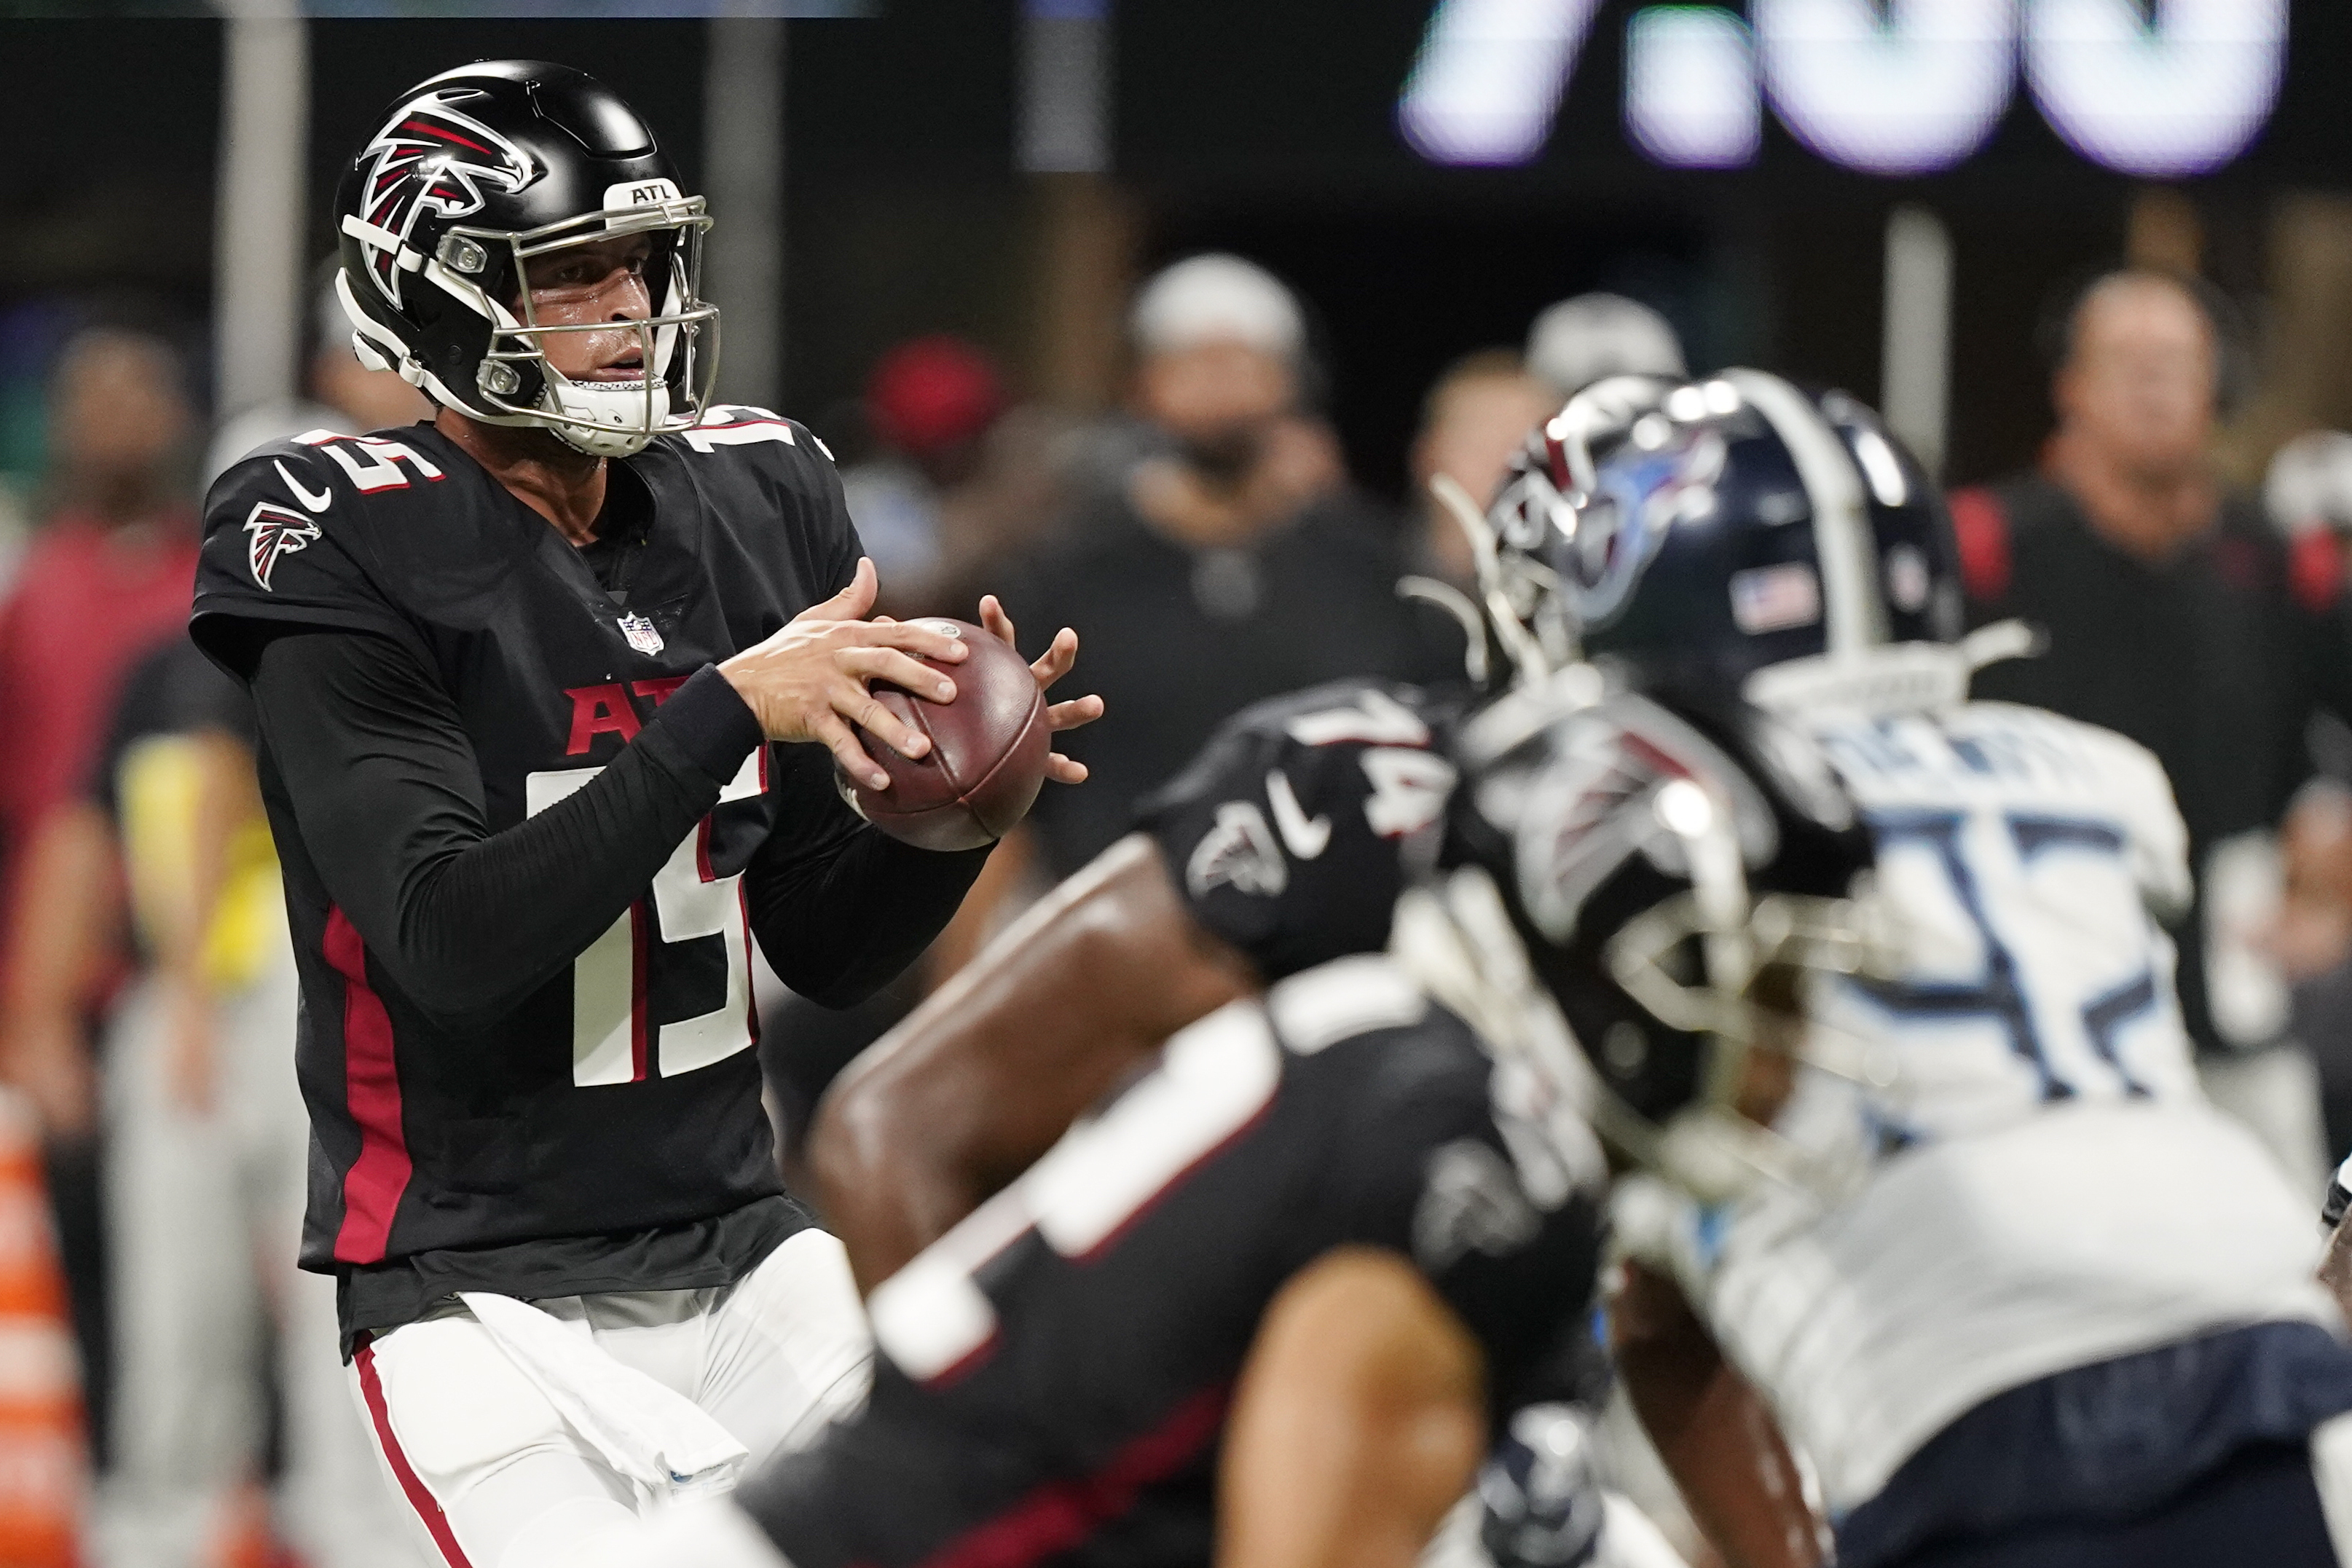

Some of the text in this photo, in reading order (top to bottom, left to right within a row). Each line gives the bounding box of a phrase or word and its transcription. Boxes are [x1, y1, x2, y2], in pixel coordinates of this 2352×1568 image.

[632, 184, 672, 205] ATL
[289, 428, 447, 495] 15
[631, 630, 658, 648] NFL
[526, 740, 770, 1088] 15
